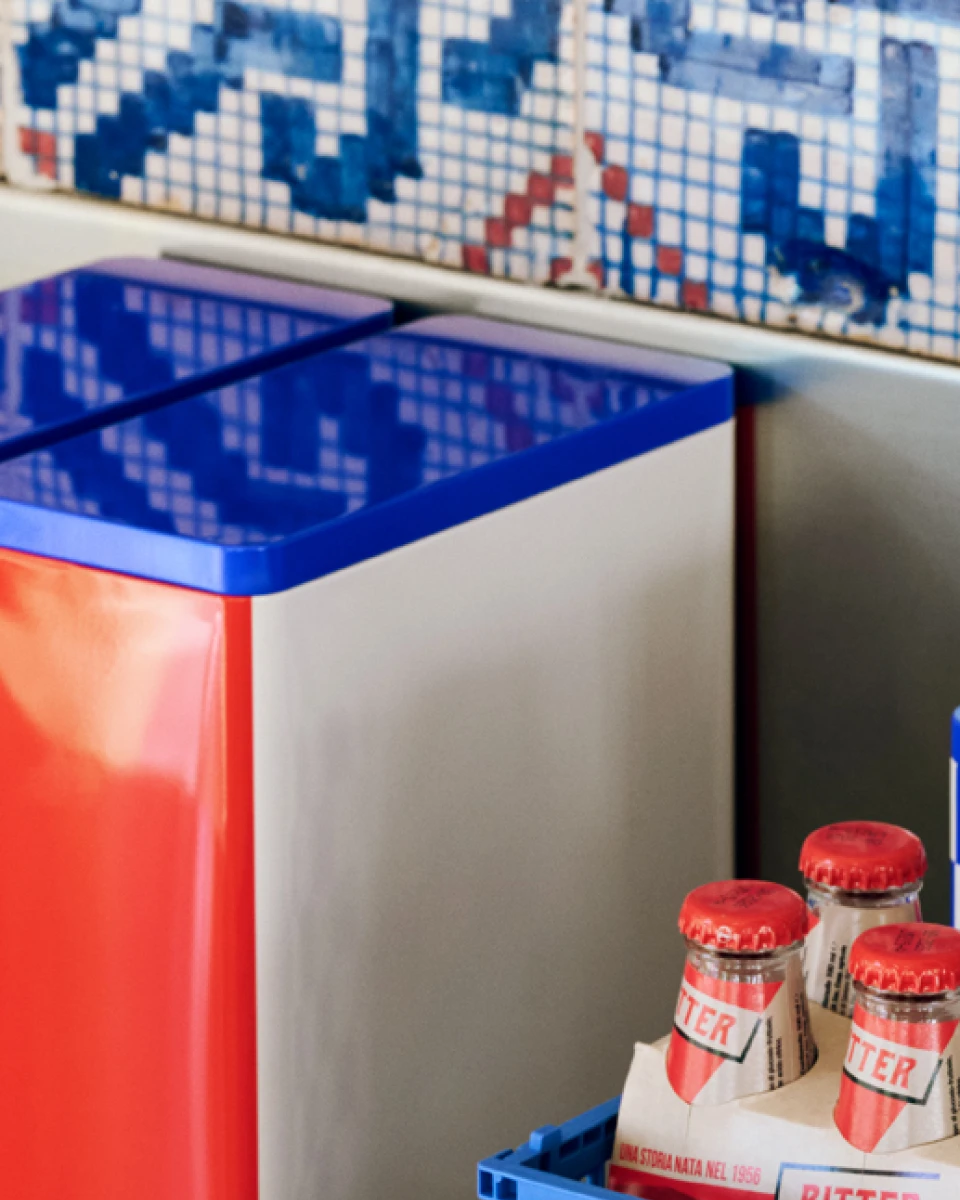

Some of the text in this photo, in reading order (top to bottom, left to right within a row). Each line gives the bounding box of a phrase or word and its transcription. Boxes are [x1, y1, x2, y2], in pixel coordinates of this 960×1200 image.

[619, 1143, 762, 1186] UNA STORIA NATA NEL 1956
